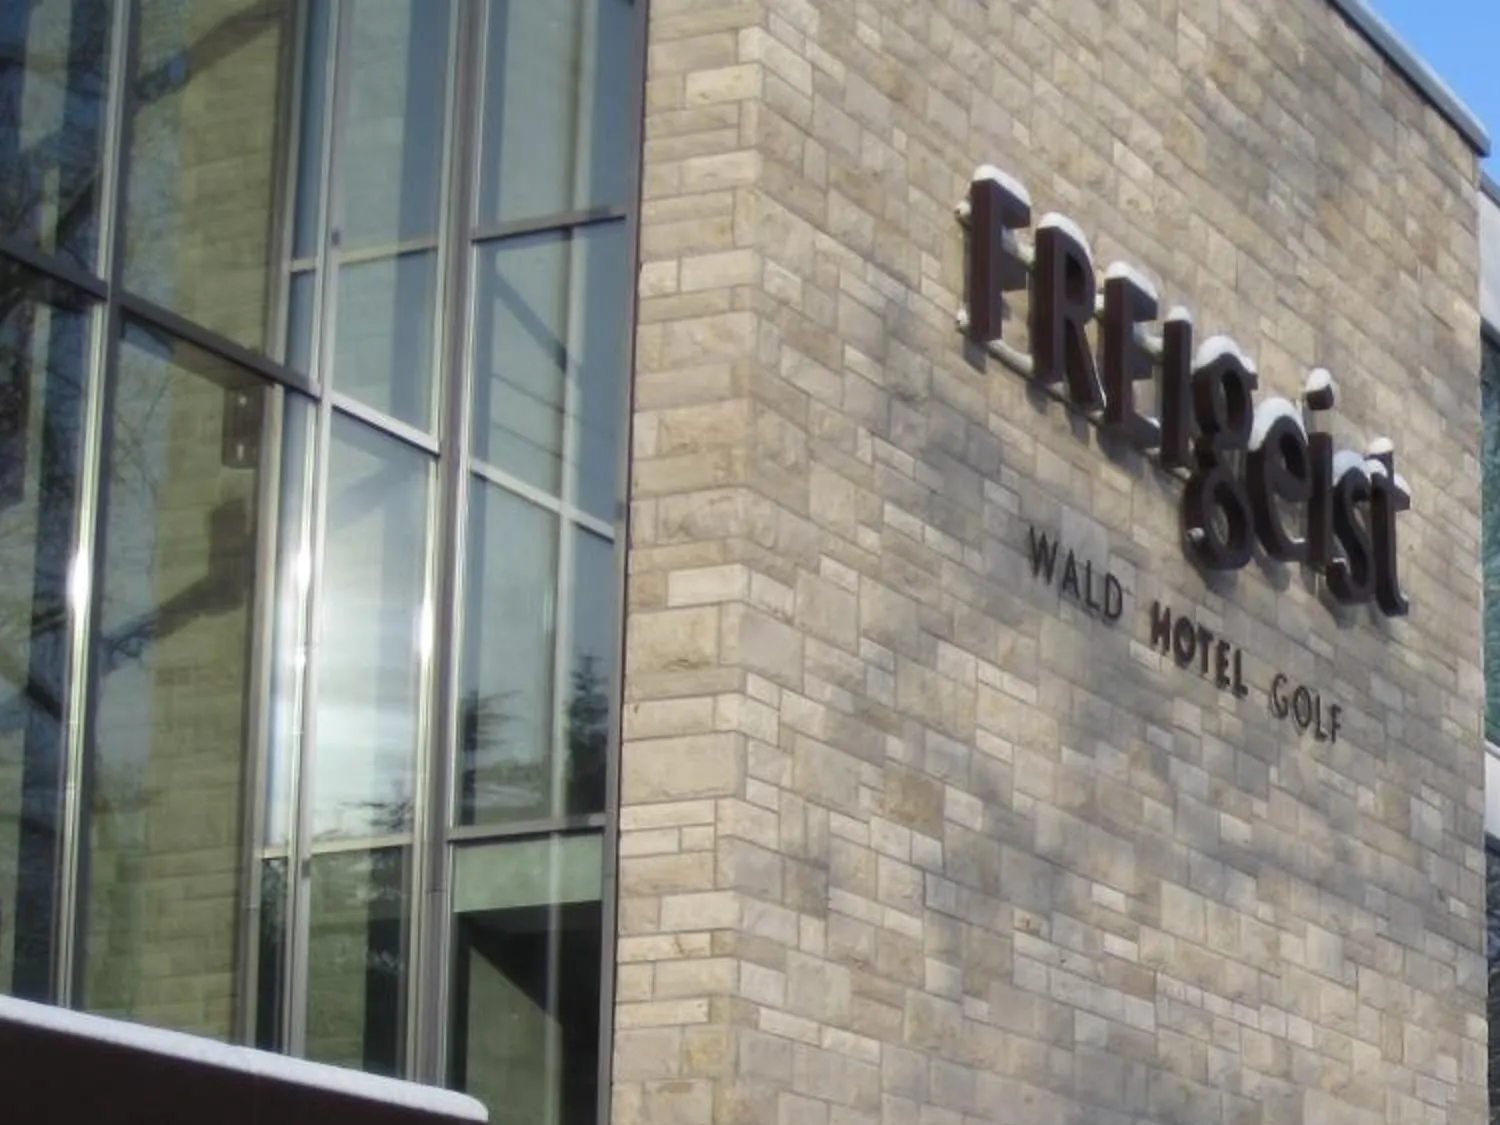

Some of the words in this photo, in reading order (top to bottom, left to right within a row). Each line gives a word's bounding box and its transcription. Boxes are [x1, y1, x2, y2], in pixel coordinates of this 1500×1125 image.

[968, 170, 1410, 616] FREIgeist
[1029, 526, 1123, 620] WALD
[1150, 601, 1248, 698] HOTEL
[1271, 674, 1344, 743] GOLF
